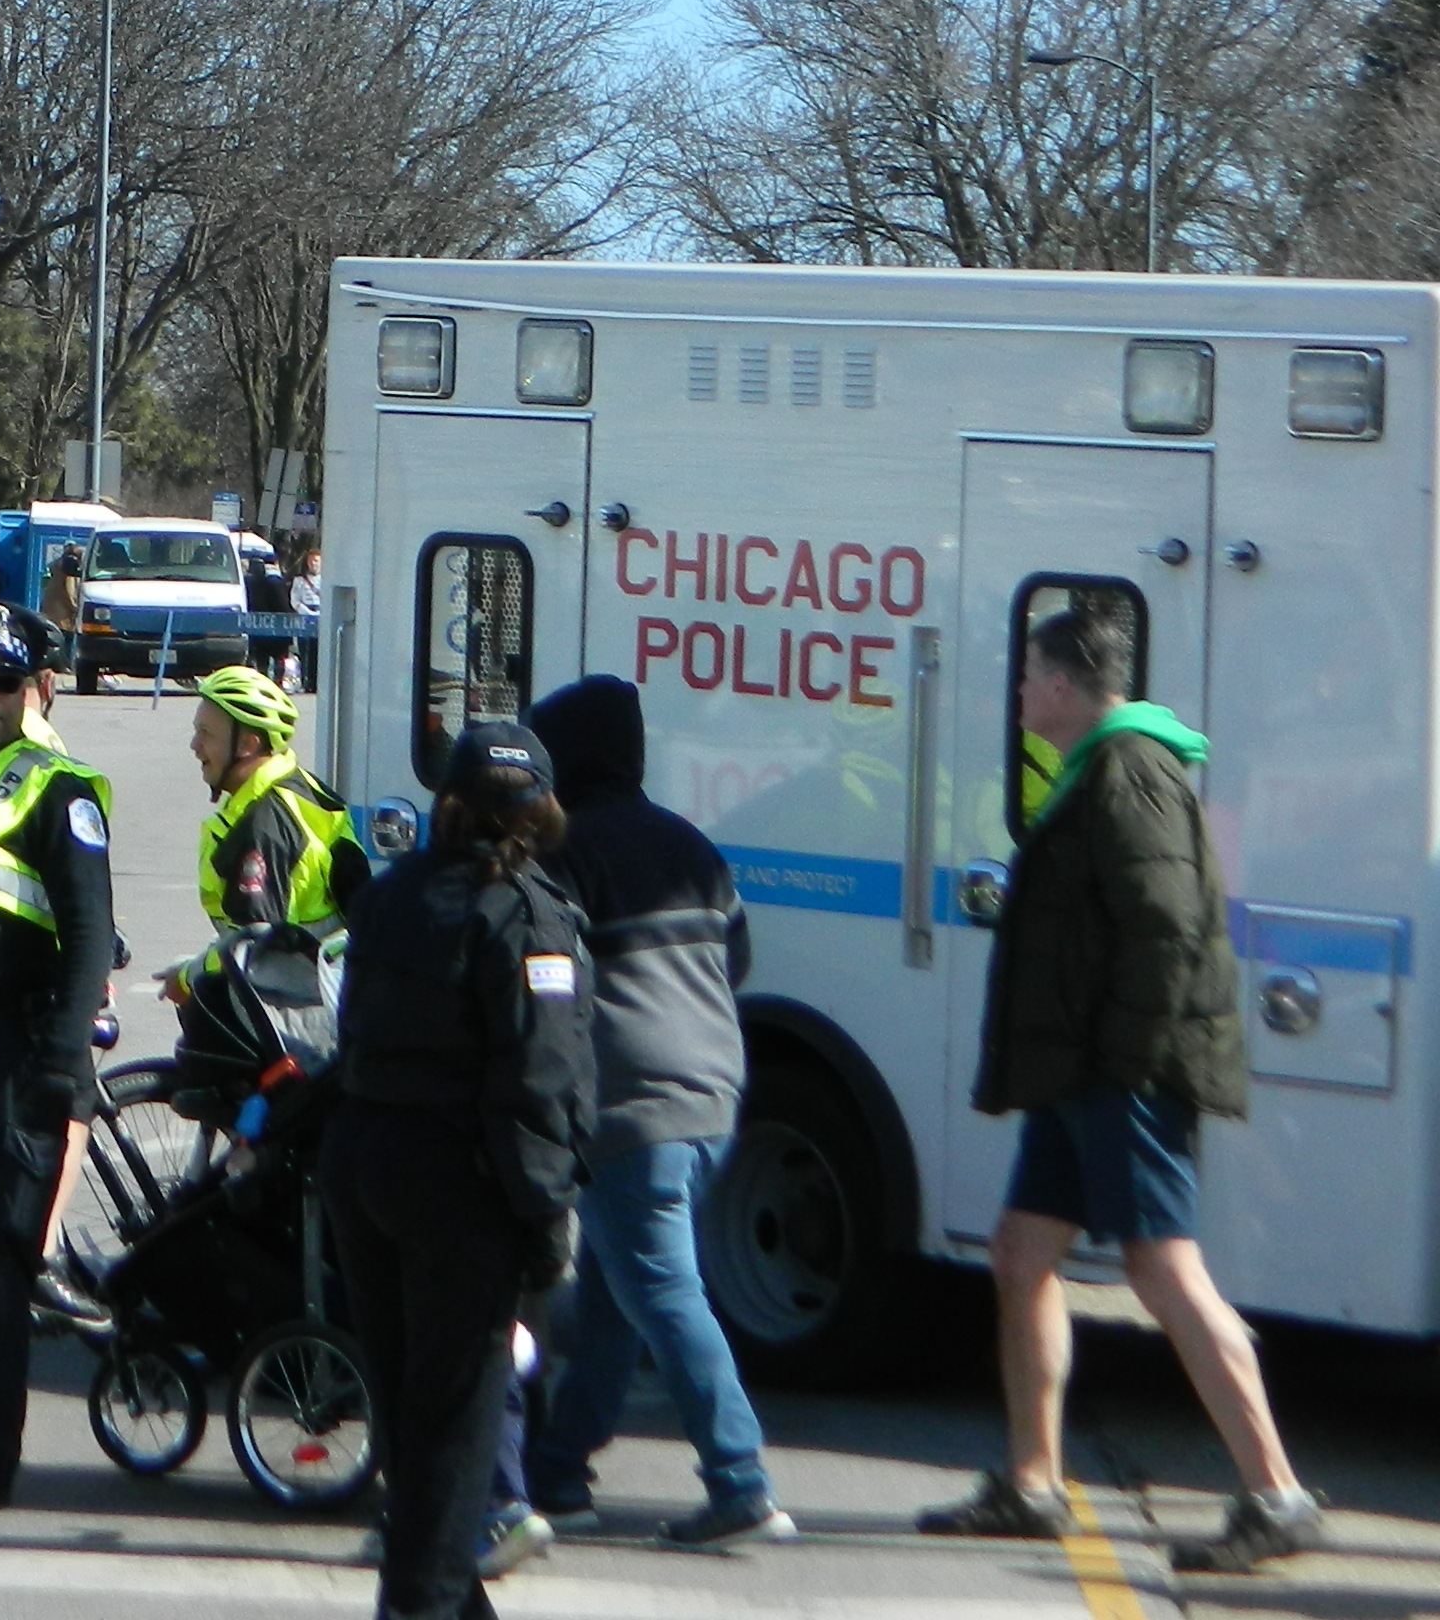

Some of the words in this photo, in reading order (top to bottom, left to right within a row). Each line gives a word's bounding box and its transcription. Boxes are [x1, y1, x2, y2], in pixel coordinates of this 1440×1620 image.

[616, 527, 925, 617] CHICAGO
[237, 613, 275, 629] POLICE
[635, 616, 895, 708] POLICE
[489, 746, 530, 761] CPD
[745, 864, 780, 886] AND
[783, 867, 857, 897] PROTECT
